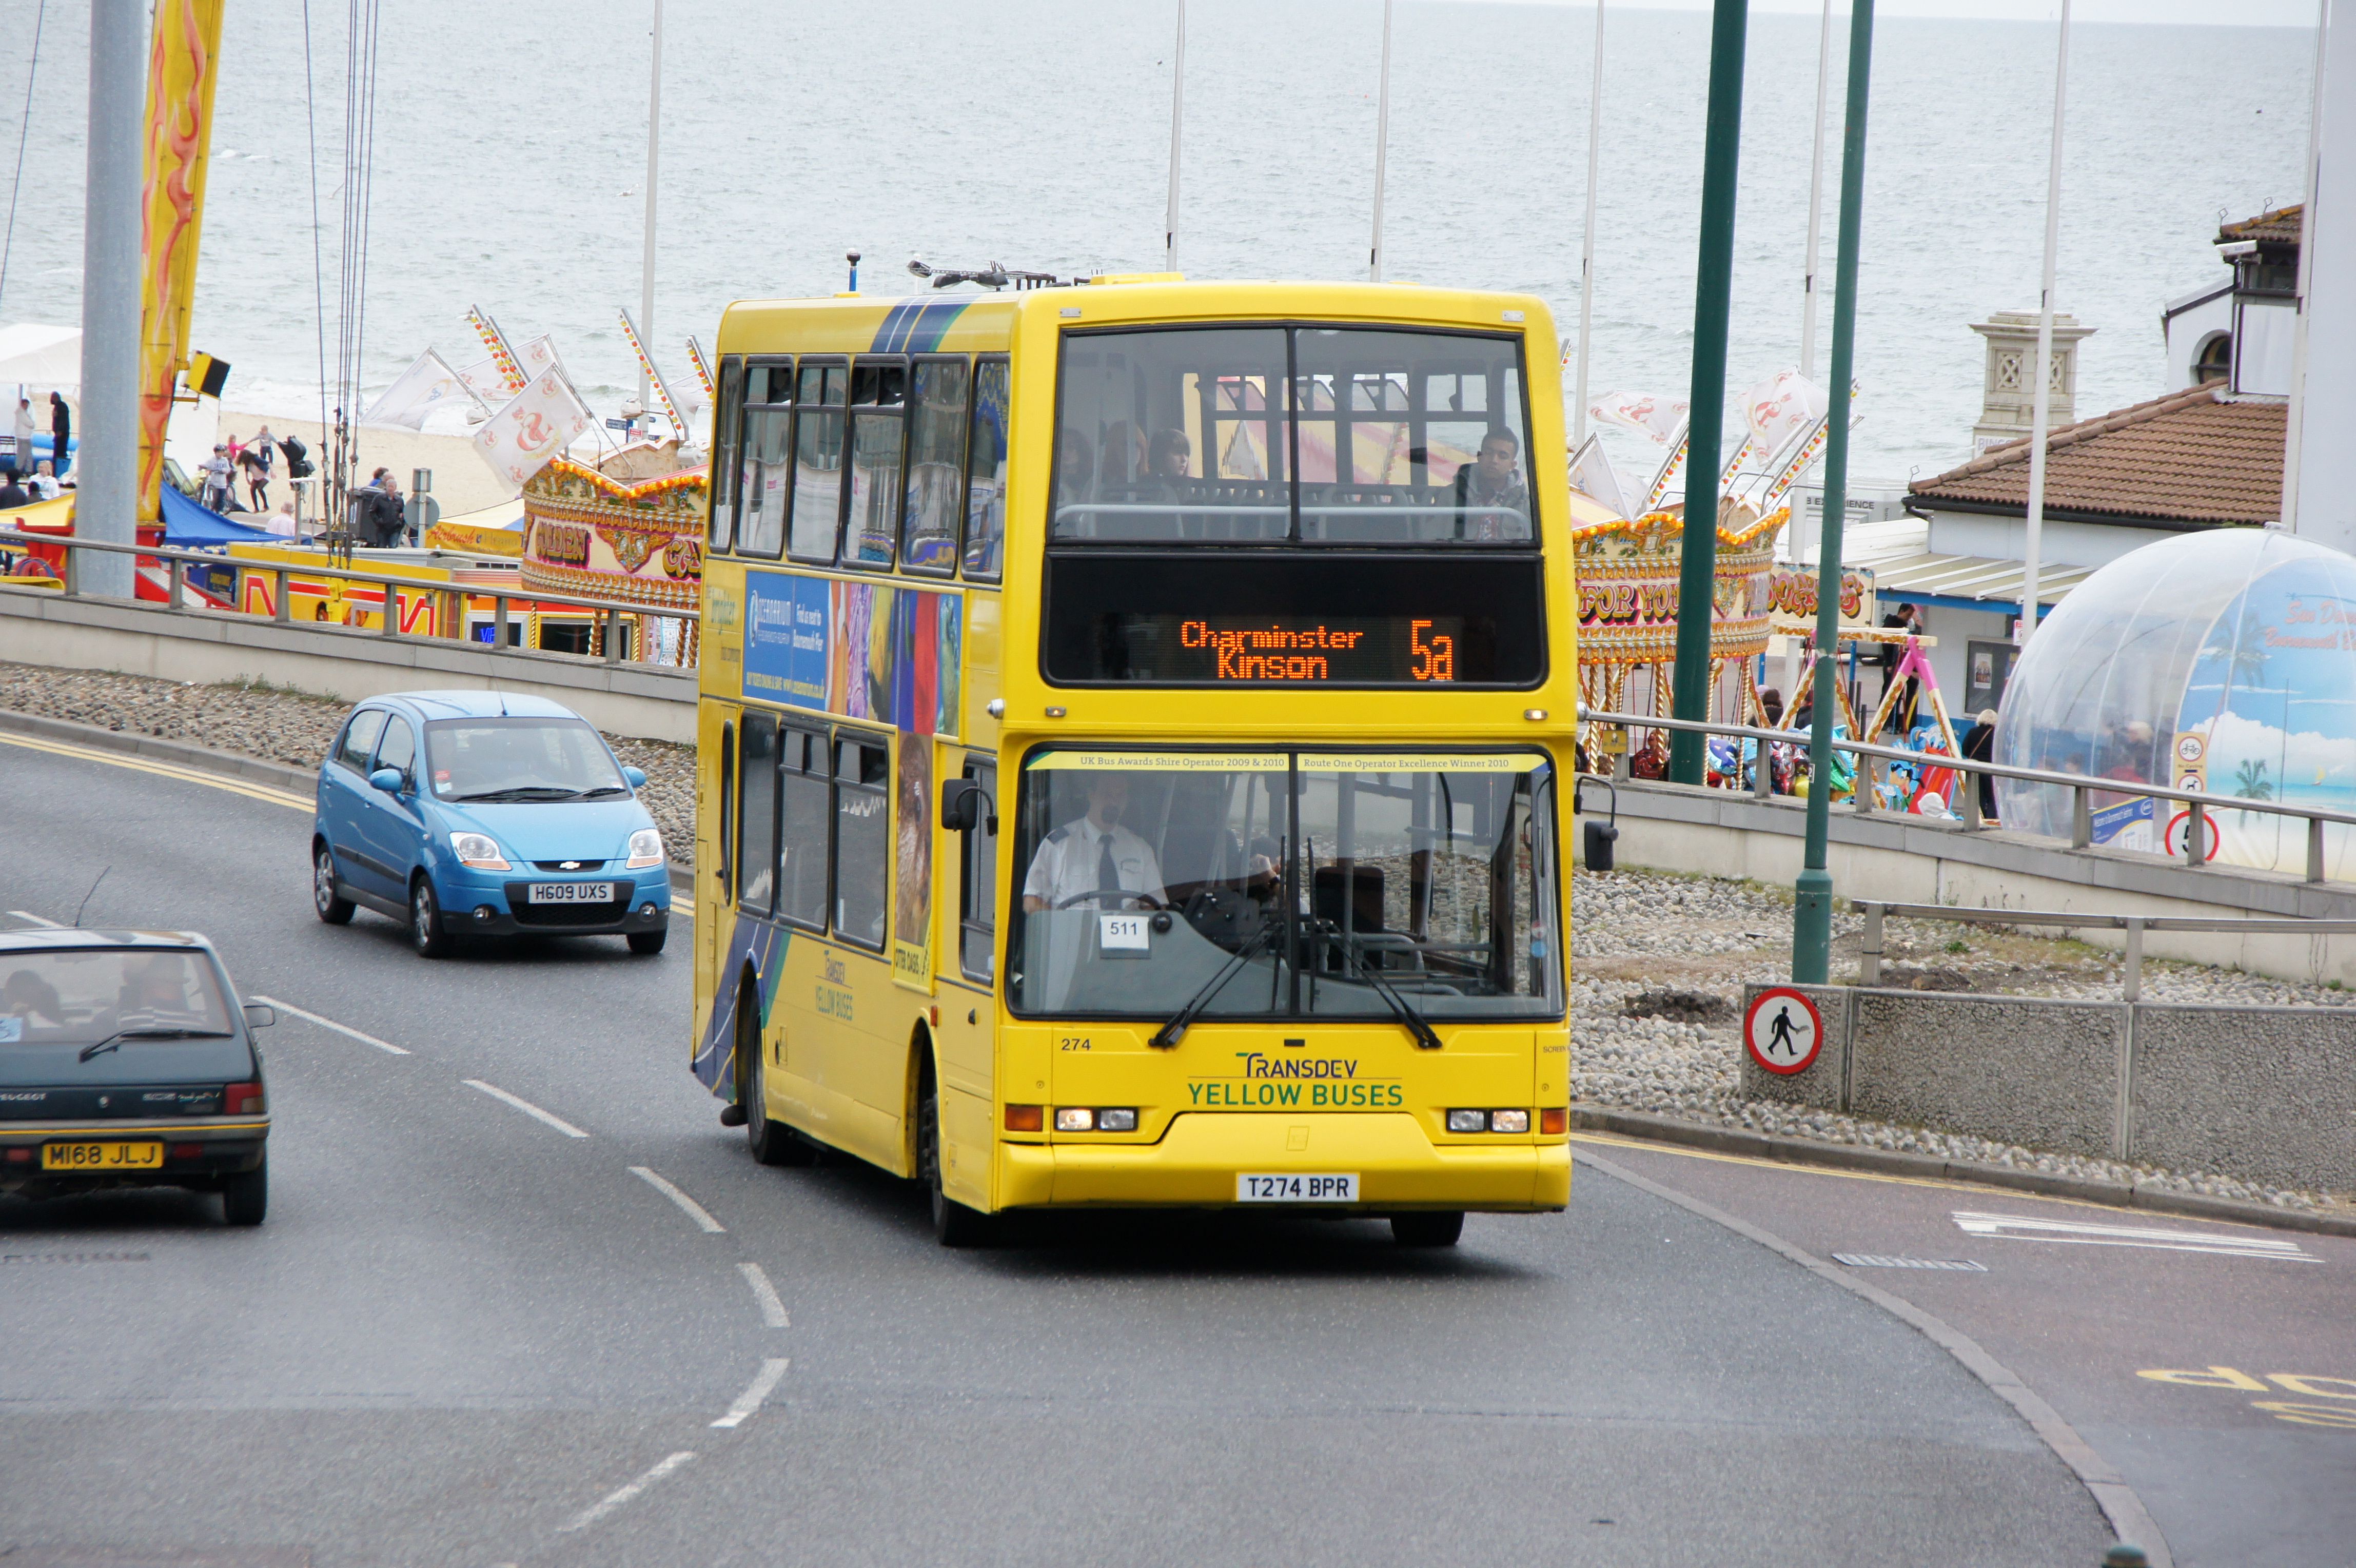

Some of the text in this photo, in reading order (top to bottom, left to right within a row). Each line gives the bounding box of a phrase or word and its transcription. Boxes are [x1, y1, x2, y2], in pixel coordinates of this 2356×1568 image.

[1578, 583, 1638, 621] FOR
[1182, 620, 1452, 679] Charminster 5a
[1218, 647, 1327, 678] Kinson
[1081, 756, 1284, 768] UK Bus Awards Shire Operator 2009 & 2010
[1304, 758, 1331, 767] Route
[1354, 759, 1397, 770] Operator
[1399, 759, 1448, 768] Excellence
[1450, 759, 1485, 768] Winner
[536, 885, 607, 899] H609 UXS
[1110, 922, 1137, 935] 511
[815, 985, 853, 1021] YELLOW BUSES
[1062, 1038, 1092, 1051] 274
[1188, 1083, 1403, 1106] YELLOW BUSES
[50, 1145, 155, 1165] M168 JLJ
[1248, 1177, 1349, 1197] T274 BPR
